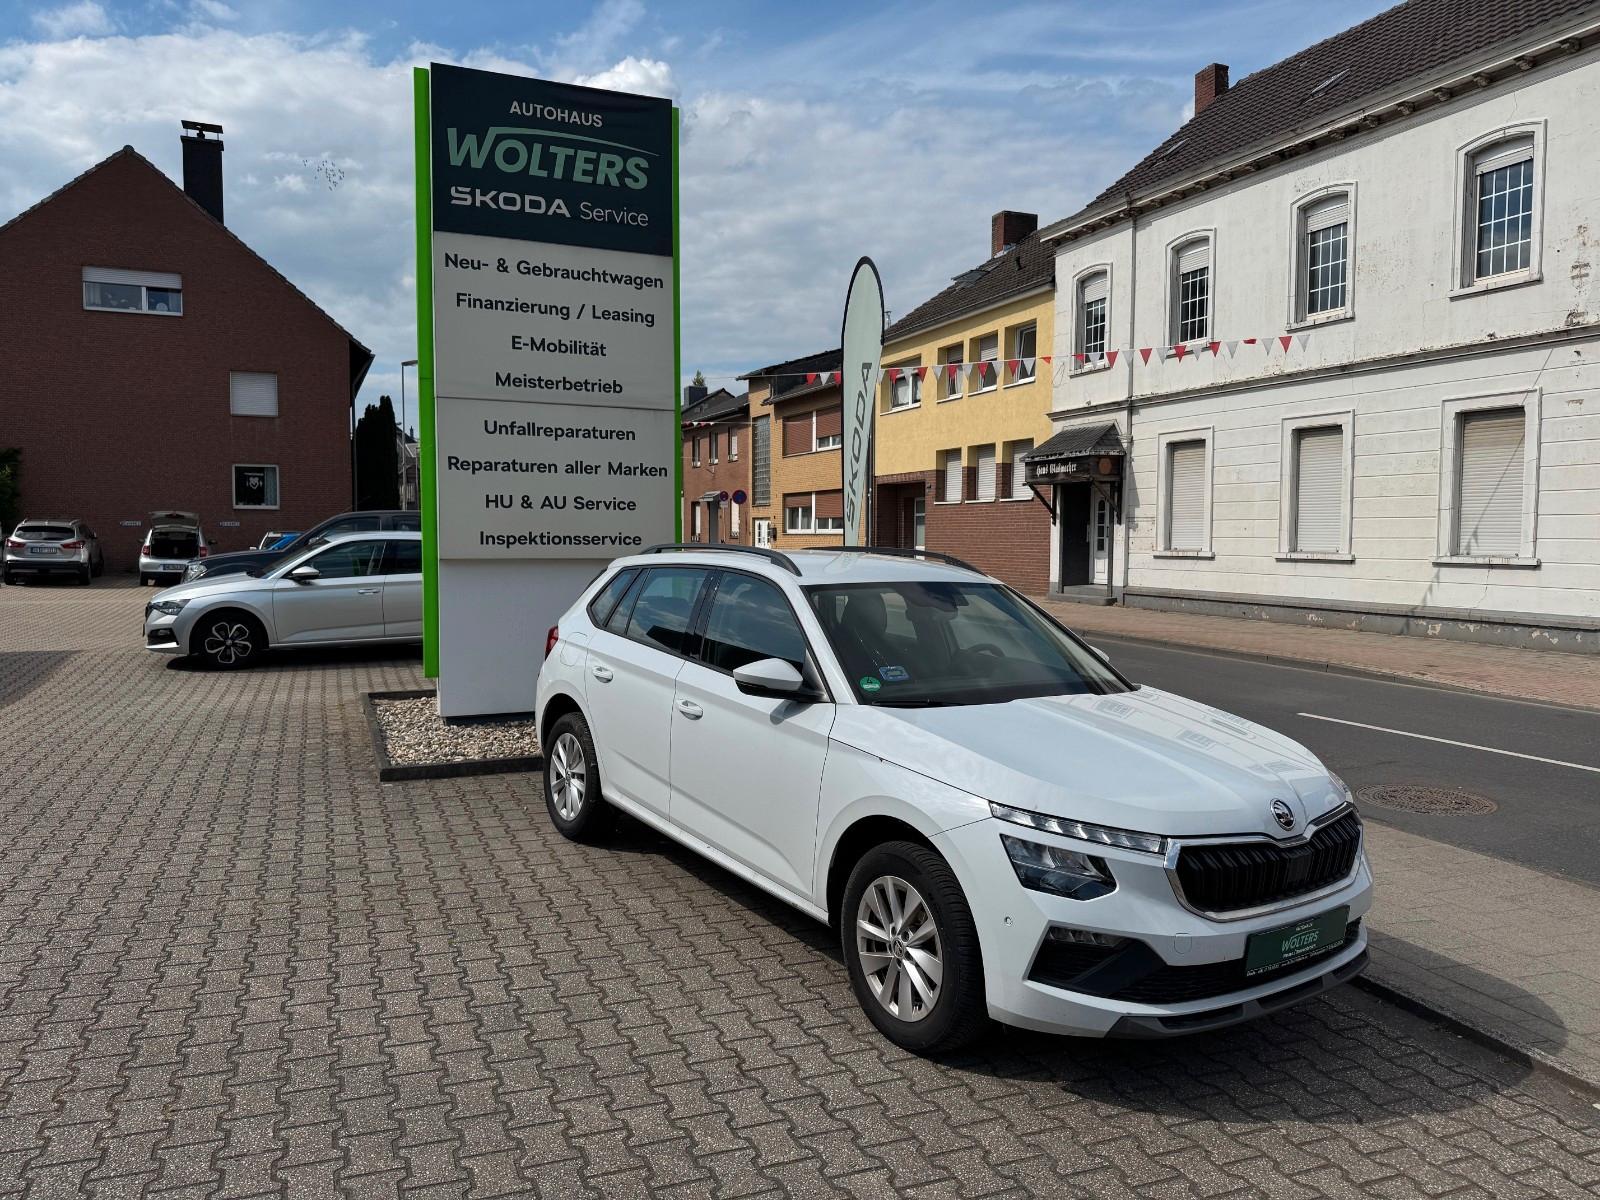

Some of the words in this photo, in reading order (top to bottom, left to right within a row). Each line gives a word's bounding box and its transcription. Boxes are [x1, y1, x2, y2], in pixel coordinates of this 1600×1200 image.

[509, 100, 603, 128] AUTOHAUS
[447, 127, 650, 190] WOLTERS
[579, 201, 649, 227] Service
[444, 252, 489, 271] Neu-
[496, 257, 510, 274] &
[516, 259, 664, 291] Gebrauchtwagen
[456, 292, 571, 321] Finanzierung
[576, 303, 586, 320] /
[591, 304, 655, 328] Leasing
[511, 335, 607, 357] E-Mobilität
[495, 371, 623, 394] Meisterbetrieb
[484, 419, 636, 441] Unfallreparaturen
[447, 455, 558, 476] Reparaturen
[564, 460, 601, 475] aller
[607, 461, 668, 477] Marken
[485, 494, 513, 510] HU
[520, 494, 533, 510] &
[540, 495, 567, 510] AU
[573, 495, 637, 511] Service
[479, 530, 642, 549] Inspektionsservice
[1281, 931, 1319, 951] WOLTERS
